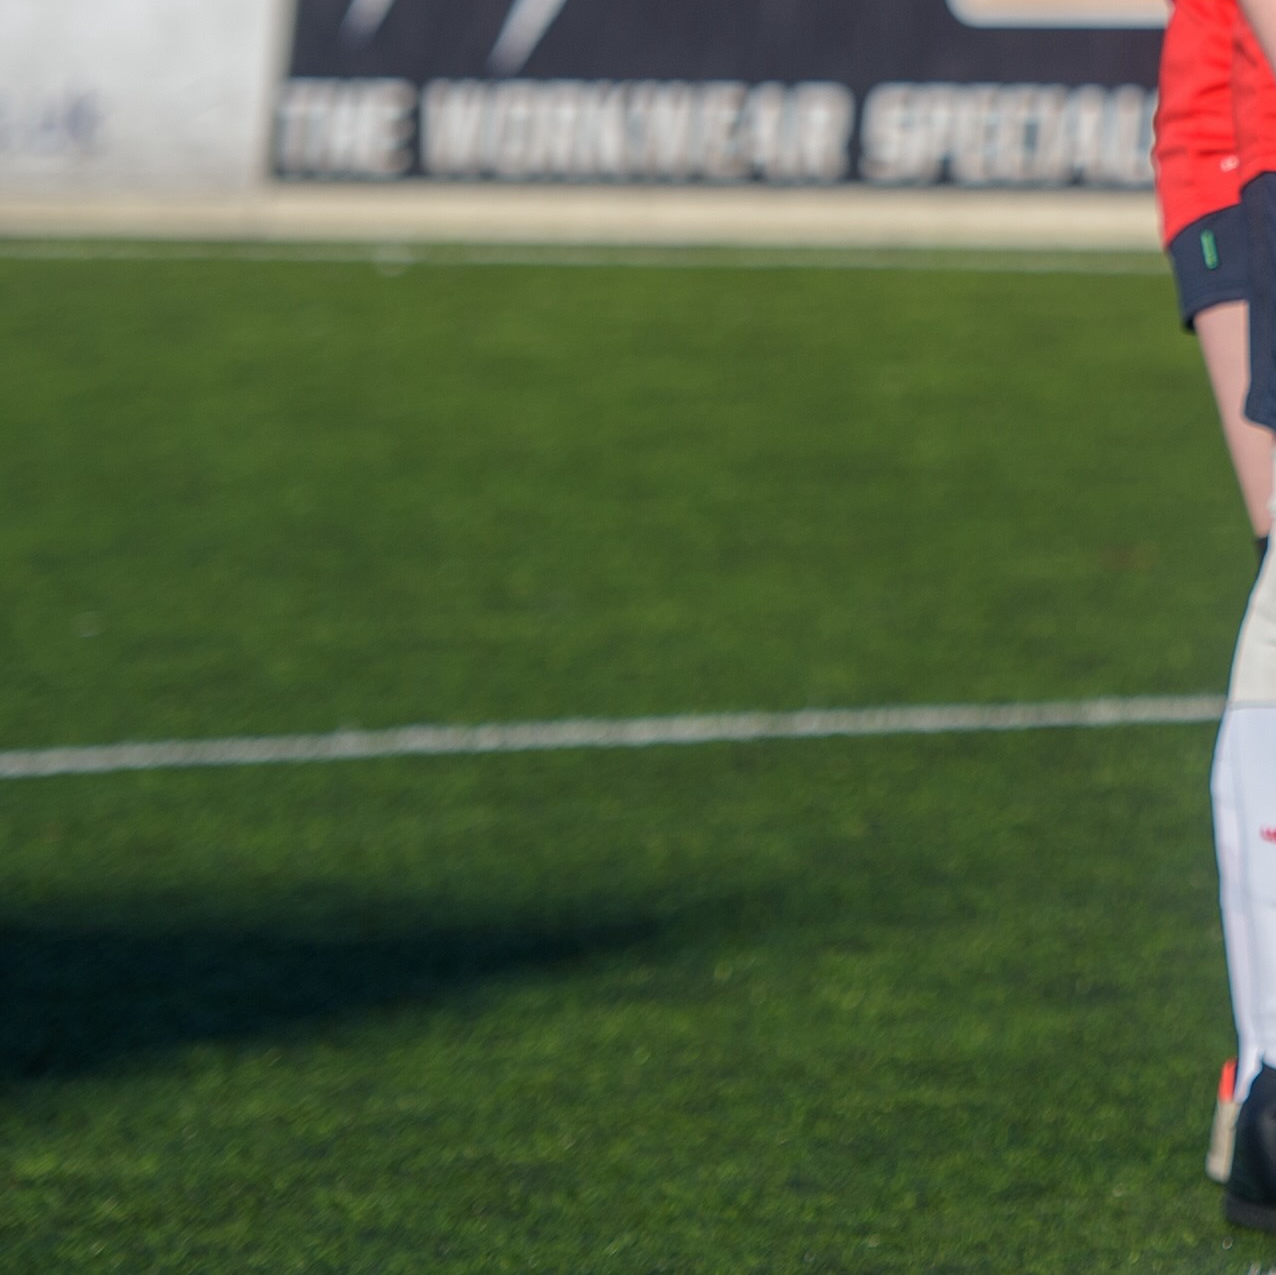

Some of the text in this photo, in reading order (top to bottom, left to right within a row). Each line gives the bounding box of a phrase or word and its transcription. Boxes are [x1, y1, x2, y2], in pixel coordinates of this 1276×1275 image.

[284, 80, 1154, 181] THE WORKWEAR SPECIAL
